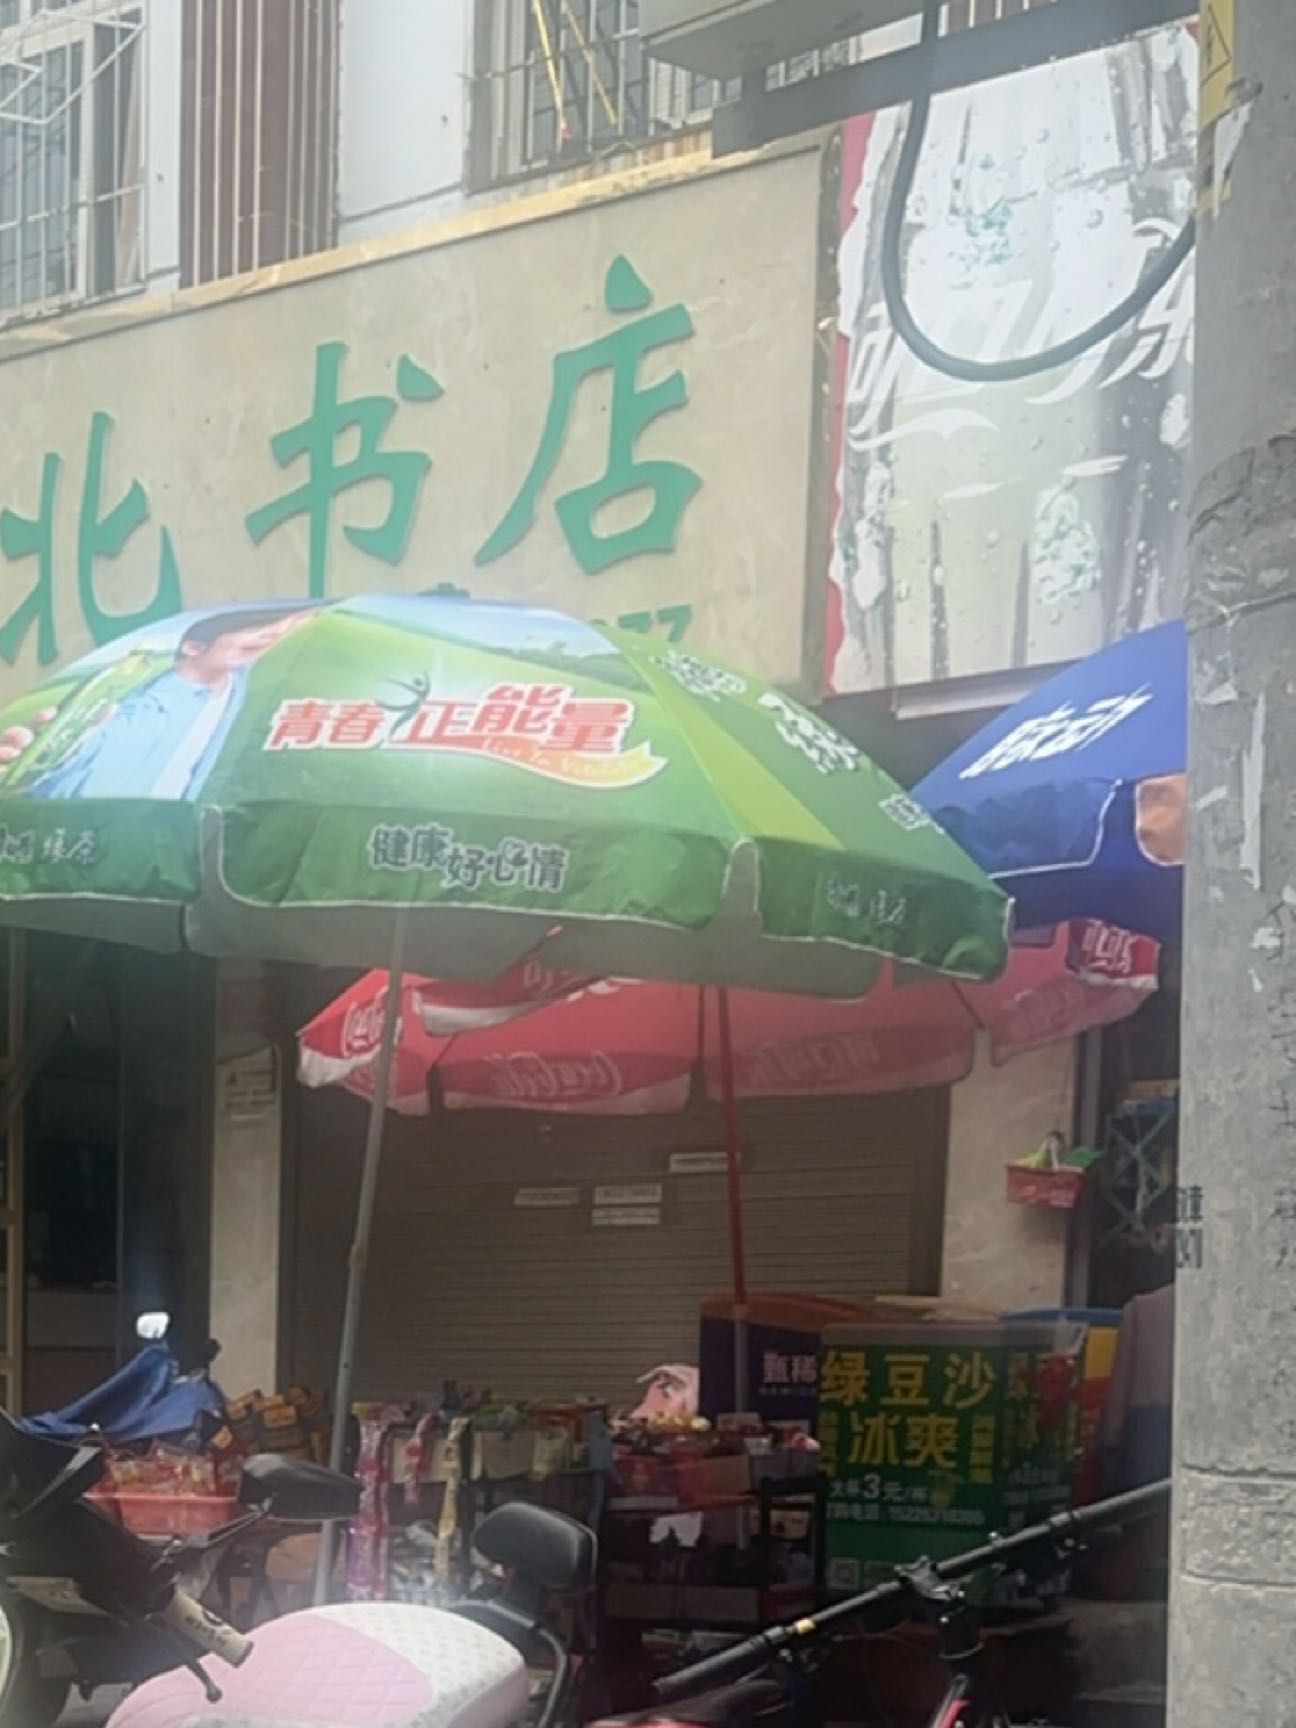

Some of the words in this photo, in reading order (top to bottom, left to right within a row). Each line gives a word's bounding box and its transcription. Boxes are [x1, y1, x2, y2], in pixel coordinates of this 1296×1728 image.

[265, 683, 633, 754] 青春正能量
[369, 822, 571, 893] 健康好心情
[819, 1350, 998, 1411] 绿豆沙
[847, 1412, 961, 1470] 冰爽
